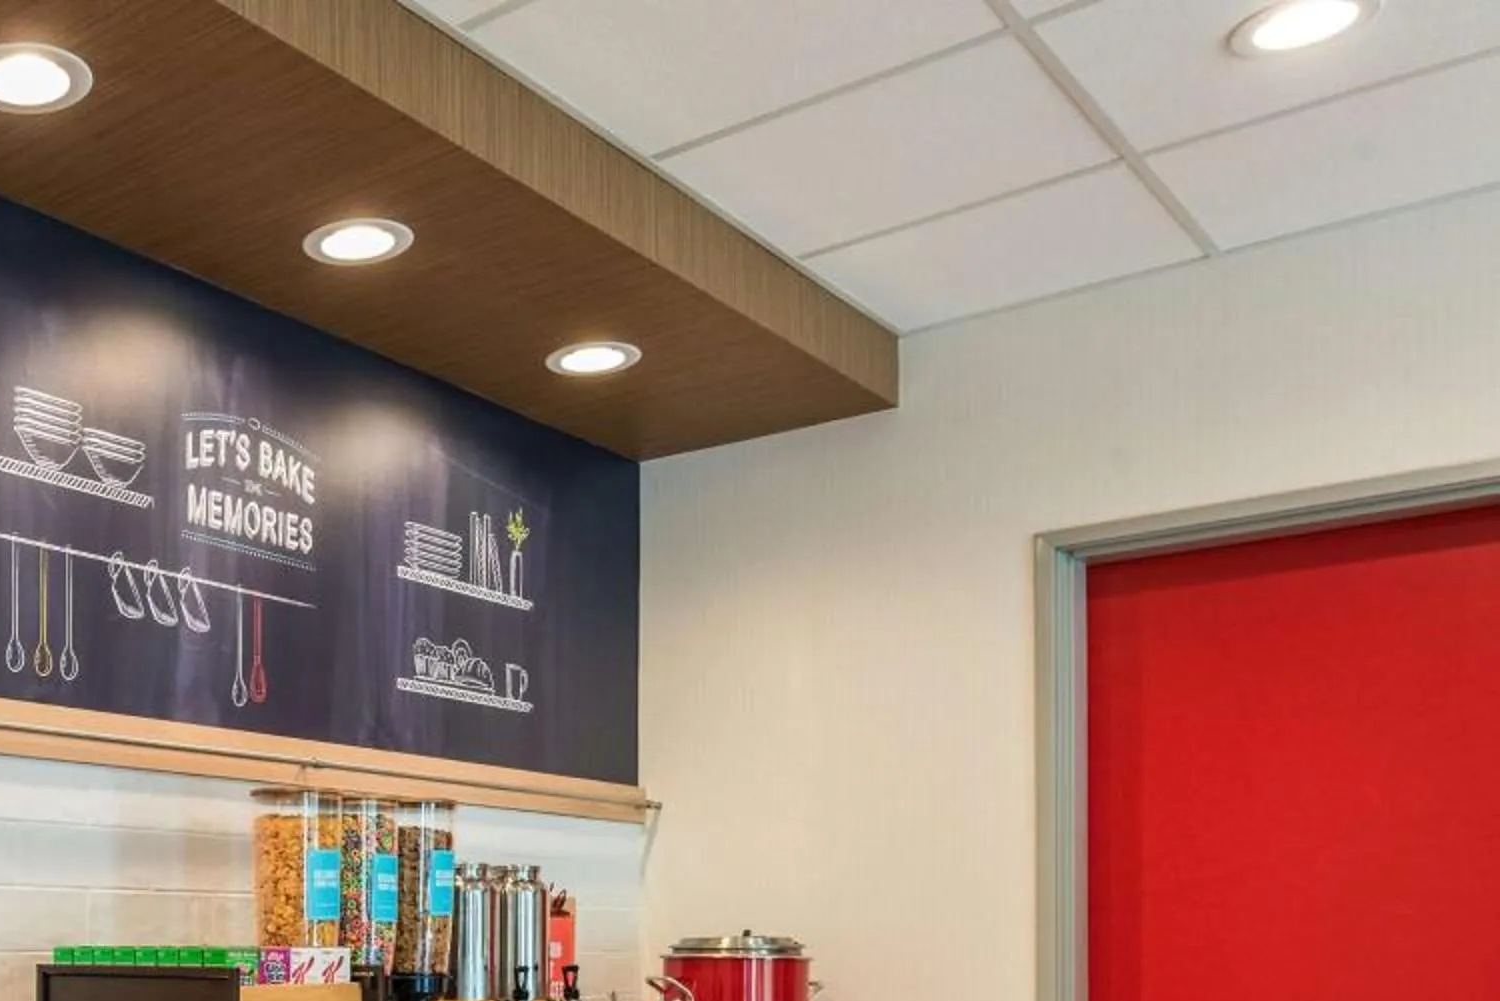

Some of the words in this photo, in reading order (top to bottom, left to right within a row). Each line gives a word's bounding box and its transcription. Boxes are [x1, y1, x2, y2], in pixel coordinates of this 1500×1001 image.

[185, 428, 251, 472] LET'S
[258, 440, 316, 505] BAKE
[187, 483, 314, 556] MEMORIES
